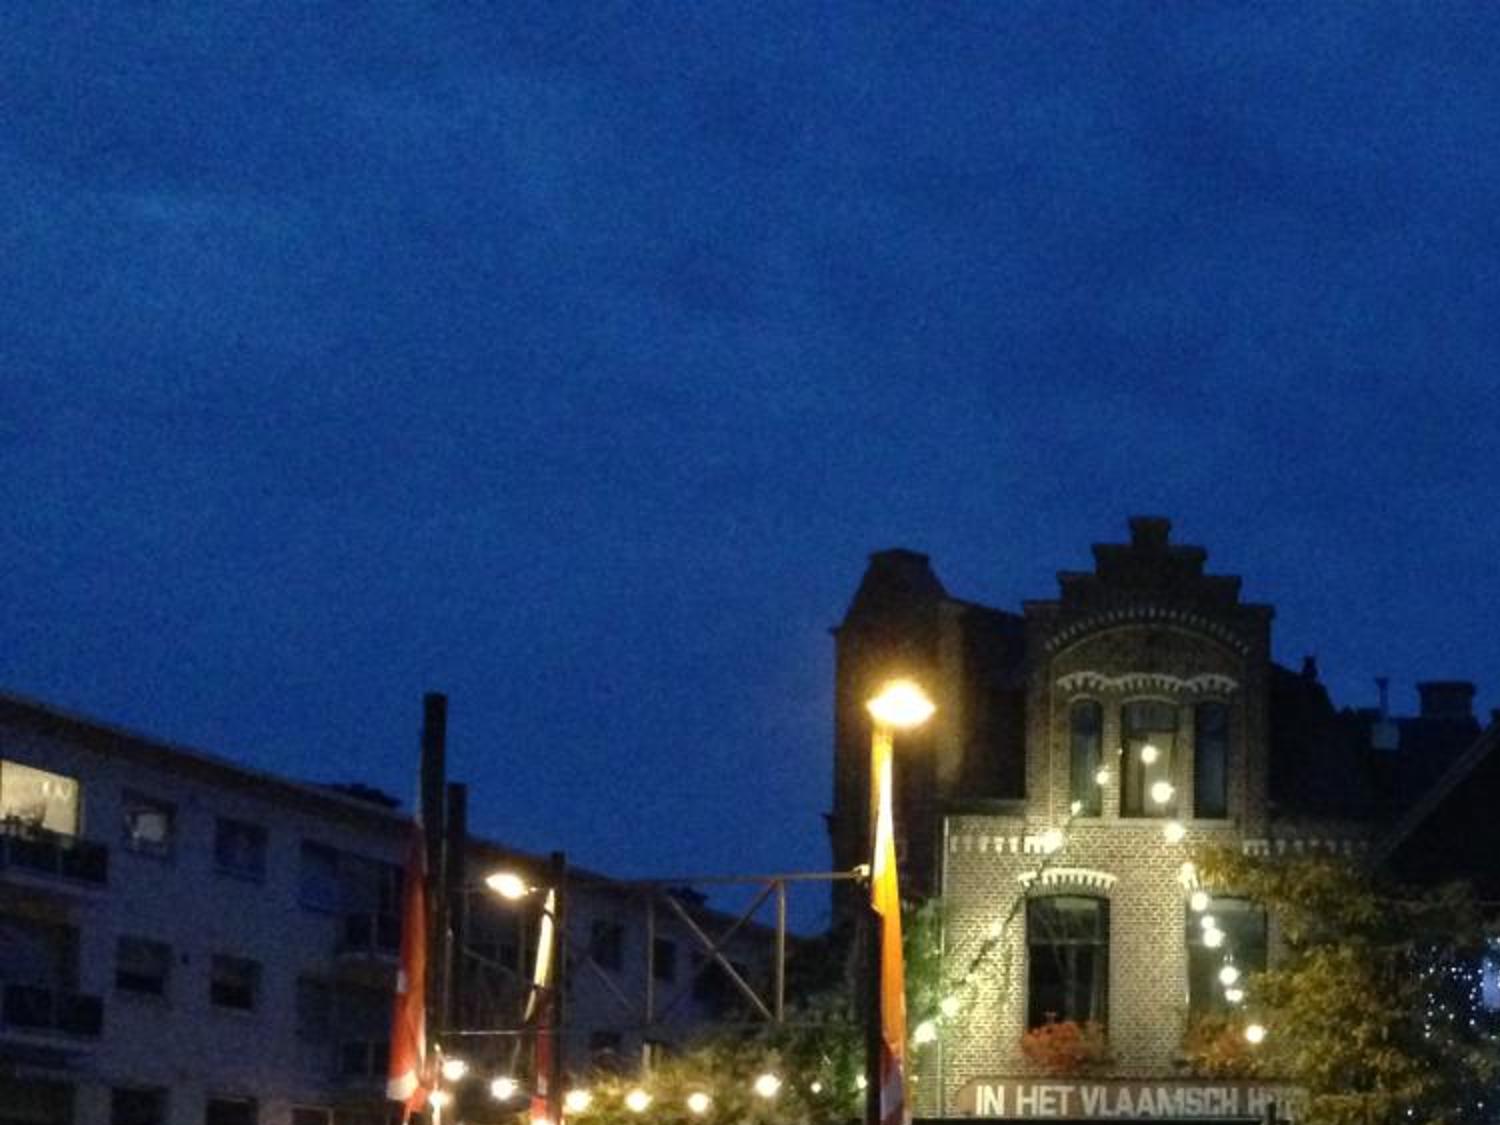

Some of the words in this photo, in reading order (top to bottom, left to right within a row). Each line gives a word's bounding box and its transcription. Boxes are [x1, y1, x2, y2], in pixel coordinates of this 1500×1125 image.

[976, 1085, 1005, 1116] IN
[1016, 1085, 1075, 1116] HET
[1080, 1086, 1237, 1116] VLAAMSCH
